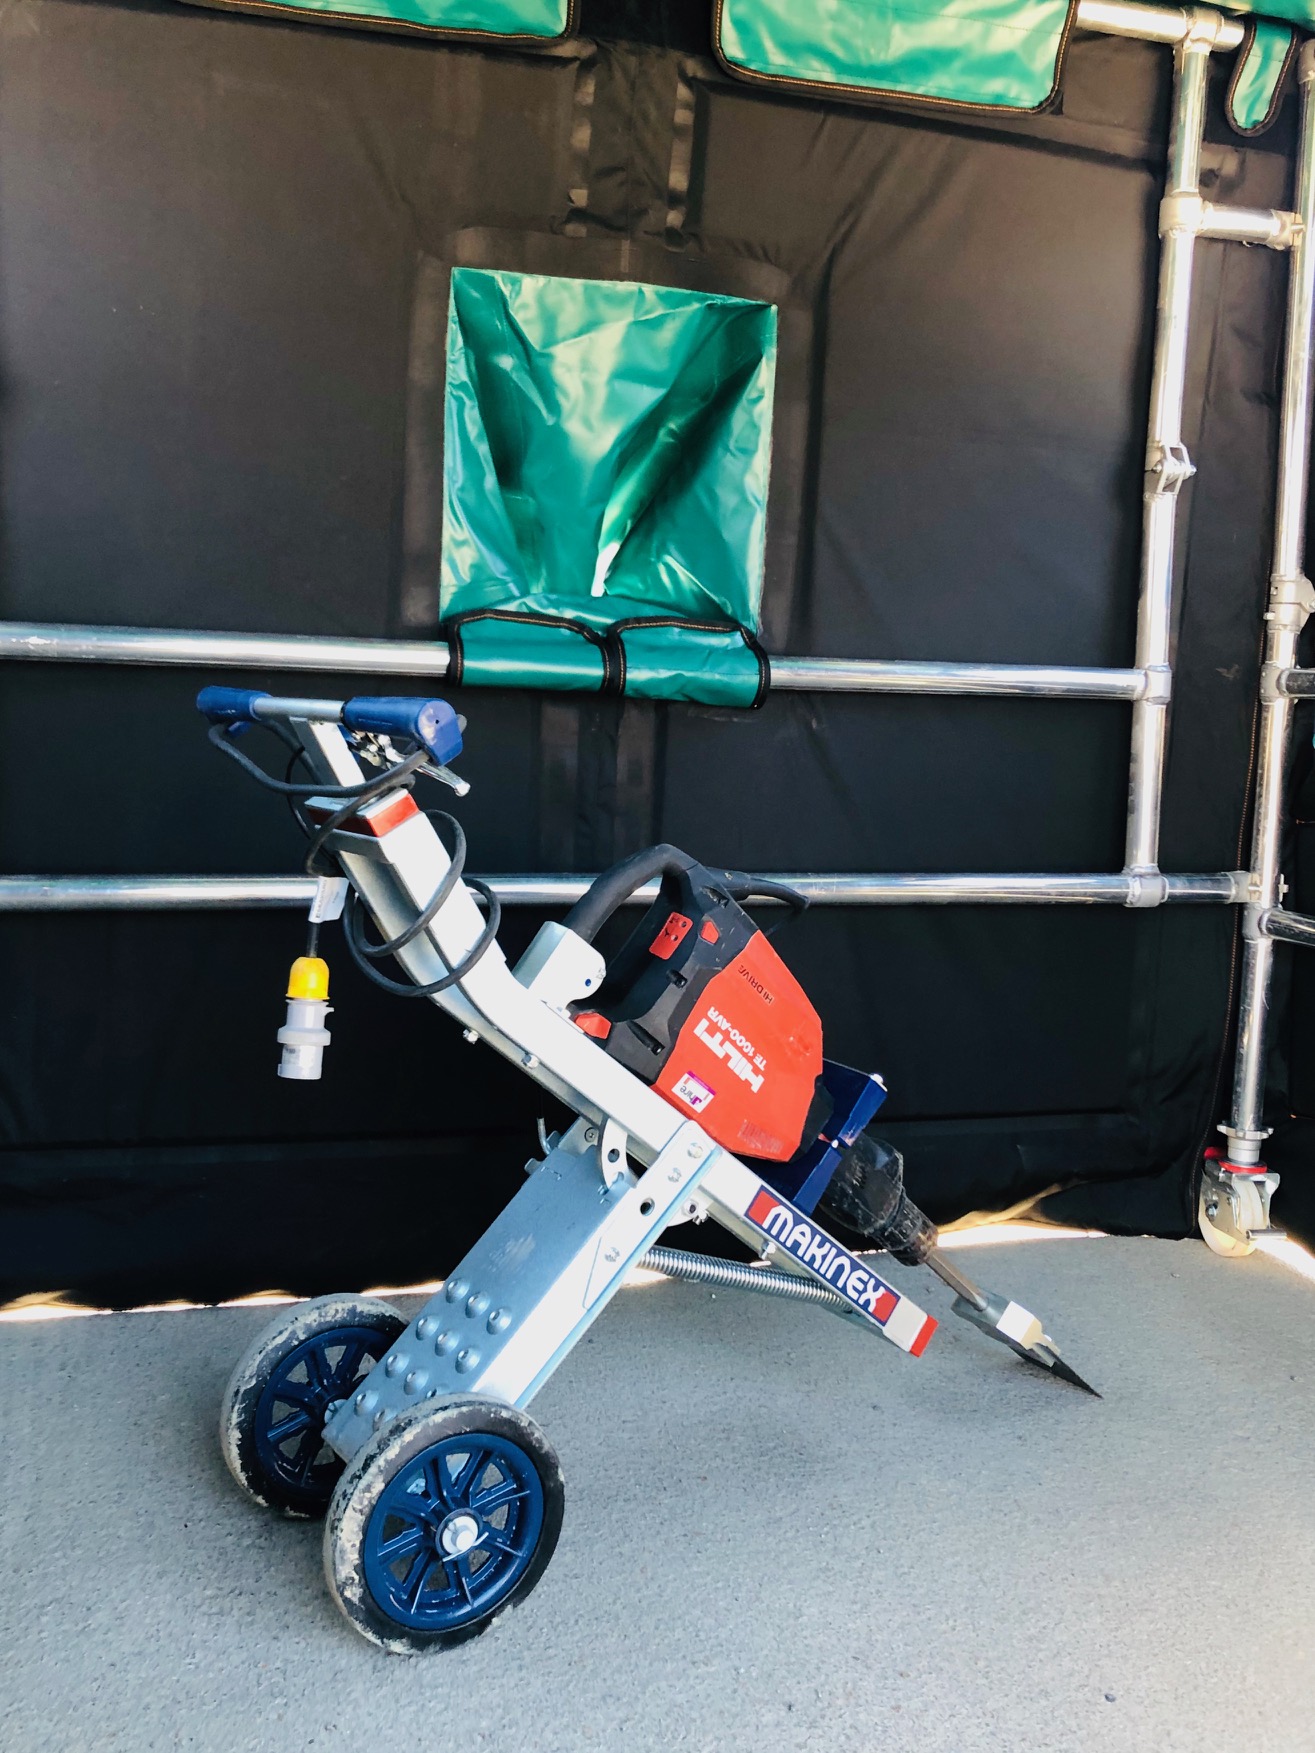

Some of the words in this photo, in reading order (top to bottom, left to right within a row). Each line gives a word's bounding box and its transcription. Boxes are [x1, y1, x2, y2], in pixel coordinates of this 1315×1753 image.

[694, 1019, 764, 1093] HILTI
[708, 1007, 755, 1056] 1000-AVR
[753, 1055, 767, 1071] TE
[762, 1205, 887, 1312] MAKINEX
